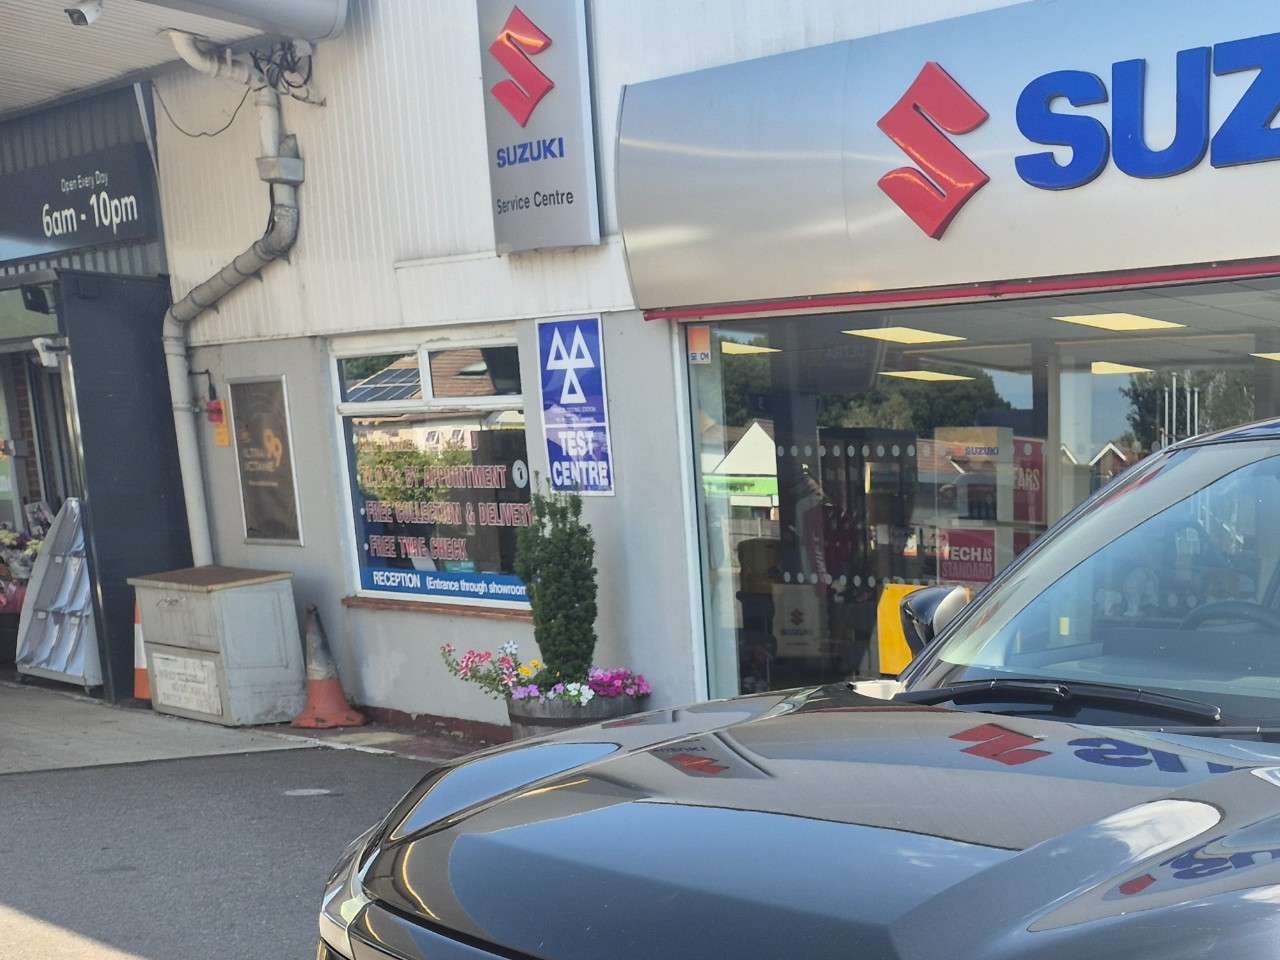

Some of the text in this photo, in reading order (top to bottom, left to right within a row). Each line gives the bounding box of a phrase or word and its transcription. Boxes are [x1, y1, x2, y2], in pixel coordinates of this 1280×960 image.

[496, 137, 564, 168] SUZUKI
[60, 170, 108, 194] Open Every Day
[42, 203, 77, 237] 6am
[90, 191, 138, 235] 10pm
[496, 189, 574, 214] Service Centre
[558, 430, 594, 456] TEST
[423, 464, 507, 488] APPOINTMENT
[552, 460, 609, 486] CENTRE
[366, 501, 533, 527] FREE COLLECTION & DELIVERY
[368, 535, 469, 561] FREE TYRE CHECK
[373, 571, 421, 588] RECEPTION
[460, 578, 488, 595] through
